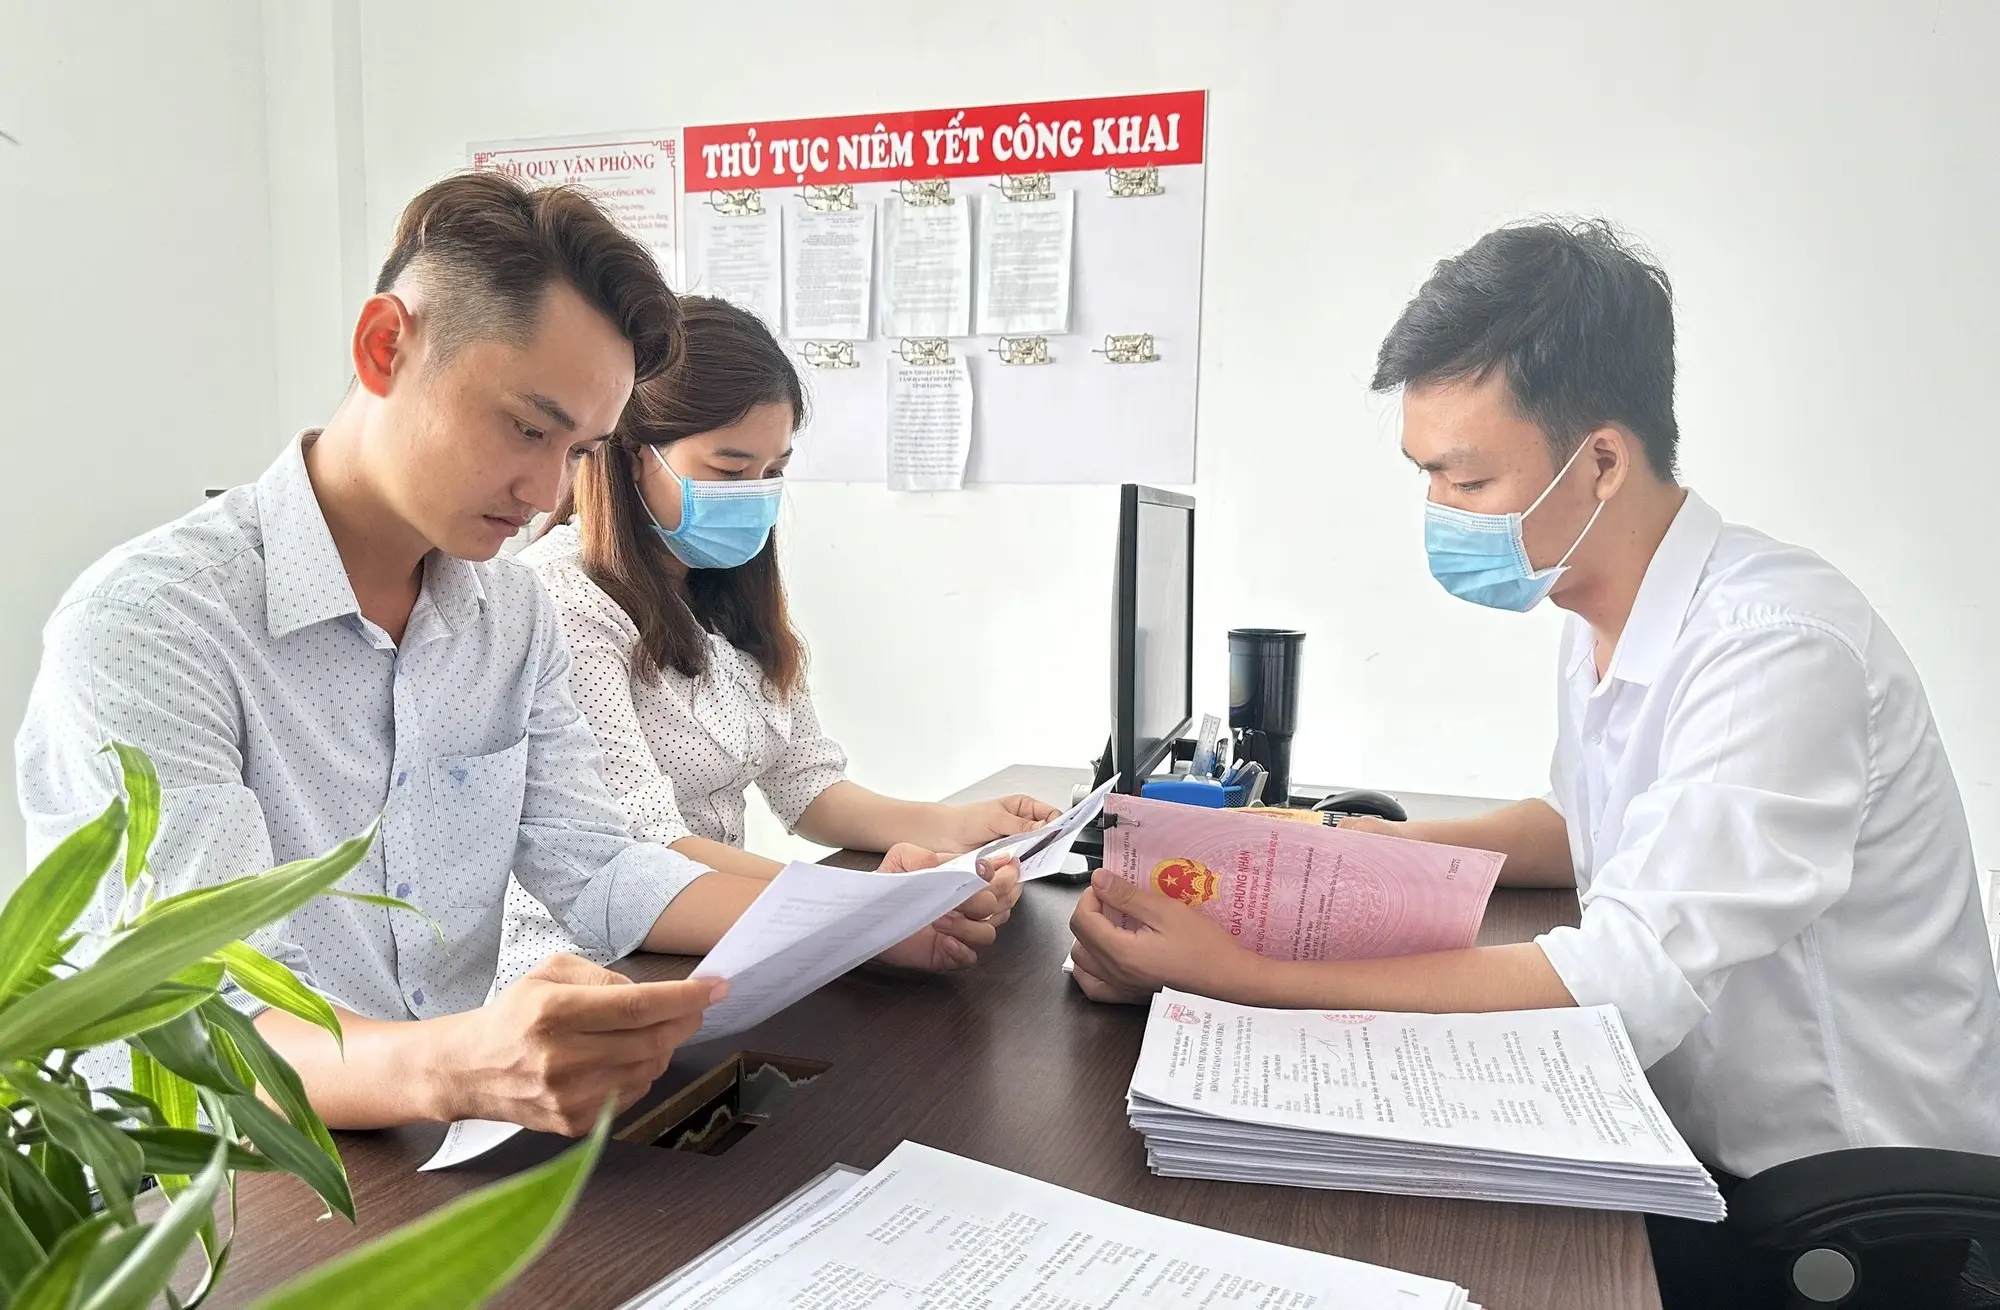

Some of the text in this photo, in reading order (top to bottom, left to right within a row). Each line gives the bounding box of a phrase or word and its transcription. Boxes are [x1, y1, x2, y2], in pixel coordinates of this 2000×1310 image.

[702, 111, 1181, 184] THỦ TỤC NIÊM YẾT CÔNG KHAI
[526, 160, 559, 179] QUY
[563, 155, 595, 175] VĂN
[599, 151, 656, 173] PHÒNG
[1233, 874, 1248, 909] CHỨNG
[1231, 911, 1243, 936] GIẤY
